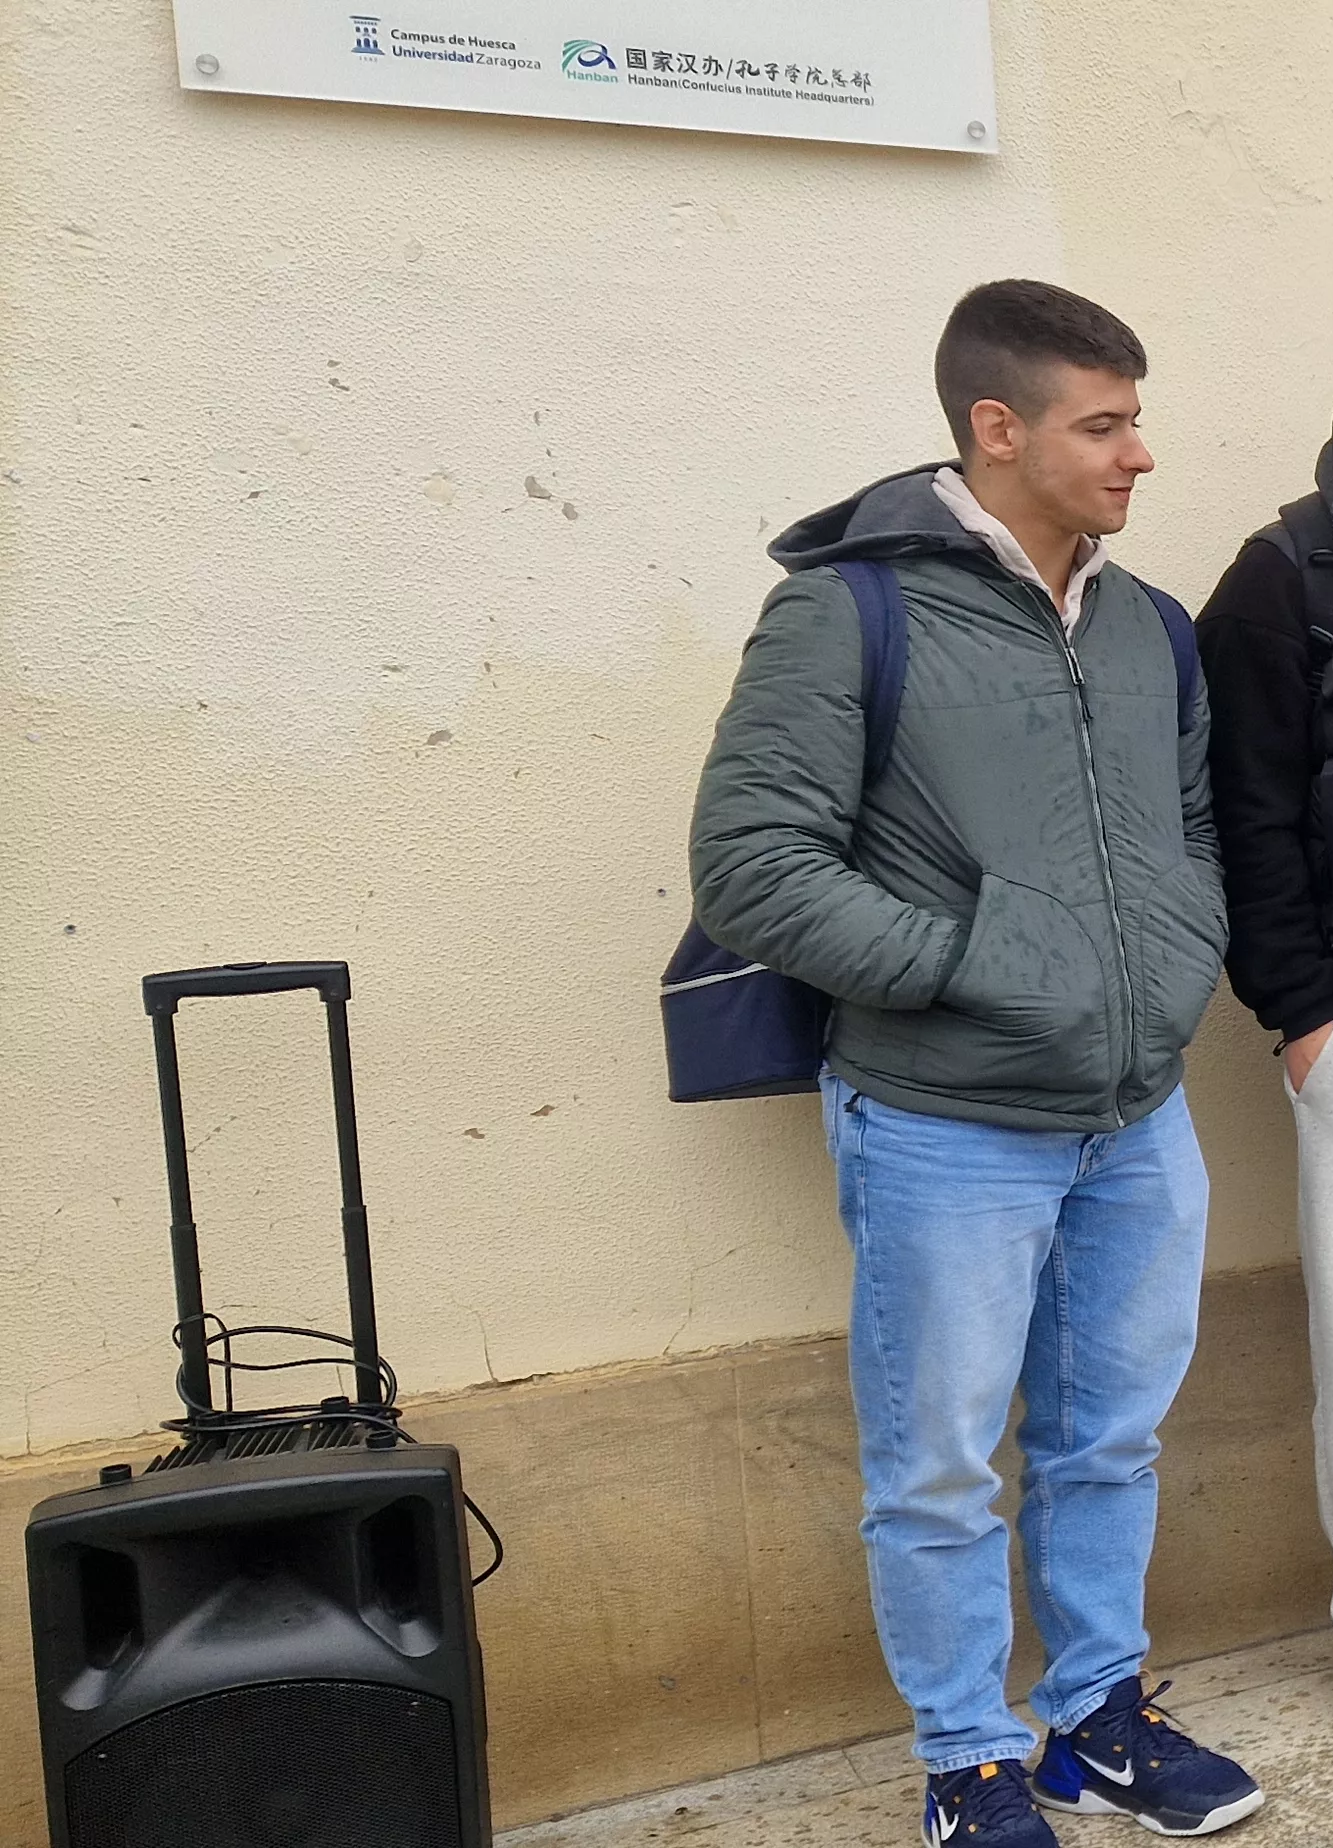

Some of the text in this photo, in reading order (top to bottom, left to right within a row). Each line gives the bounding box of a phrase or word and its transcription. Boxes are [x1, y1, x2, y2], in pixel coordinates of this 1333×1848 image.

[390, 28, 516, 51] Campus de Huesca
[392, 45, 474, 64] Universidad
[475, 53, 542, 70] Zaragoza
[566, 69, 619, 84] Hanban
[627, 73, 876, 107] Hanban(Confucius Institute Headquarters)
